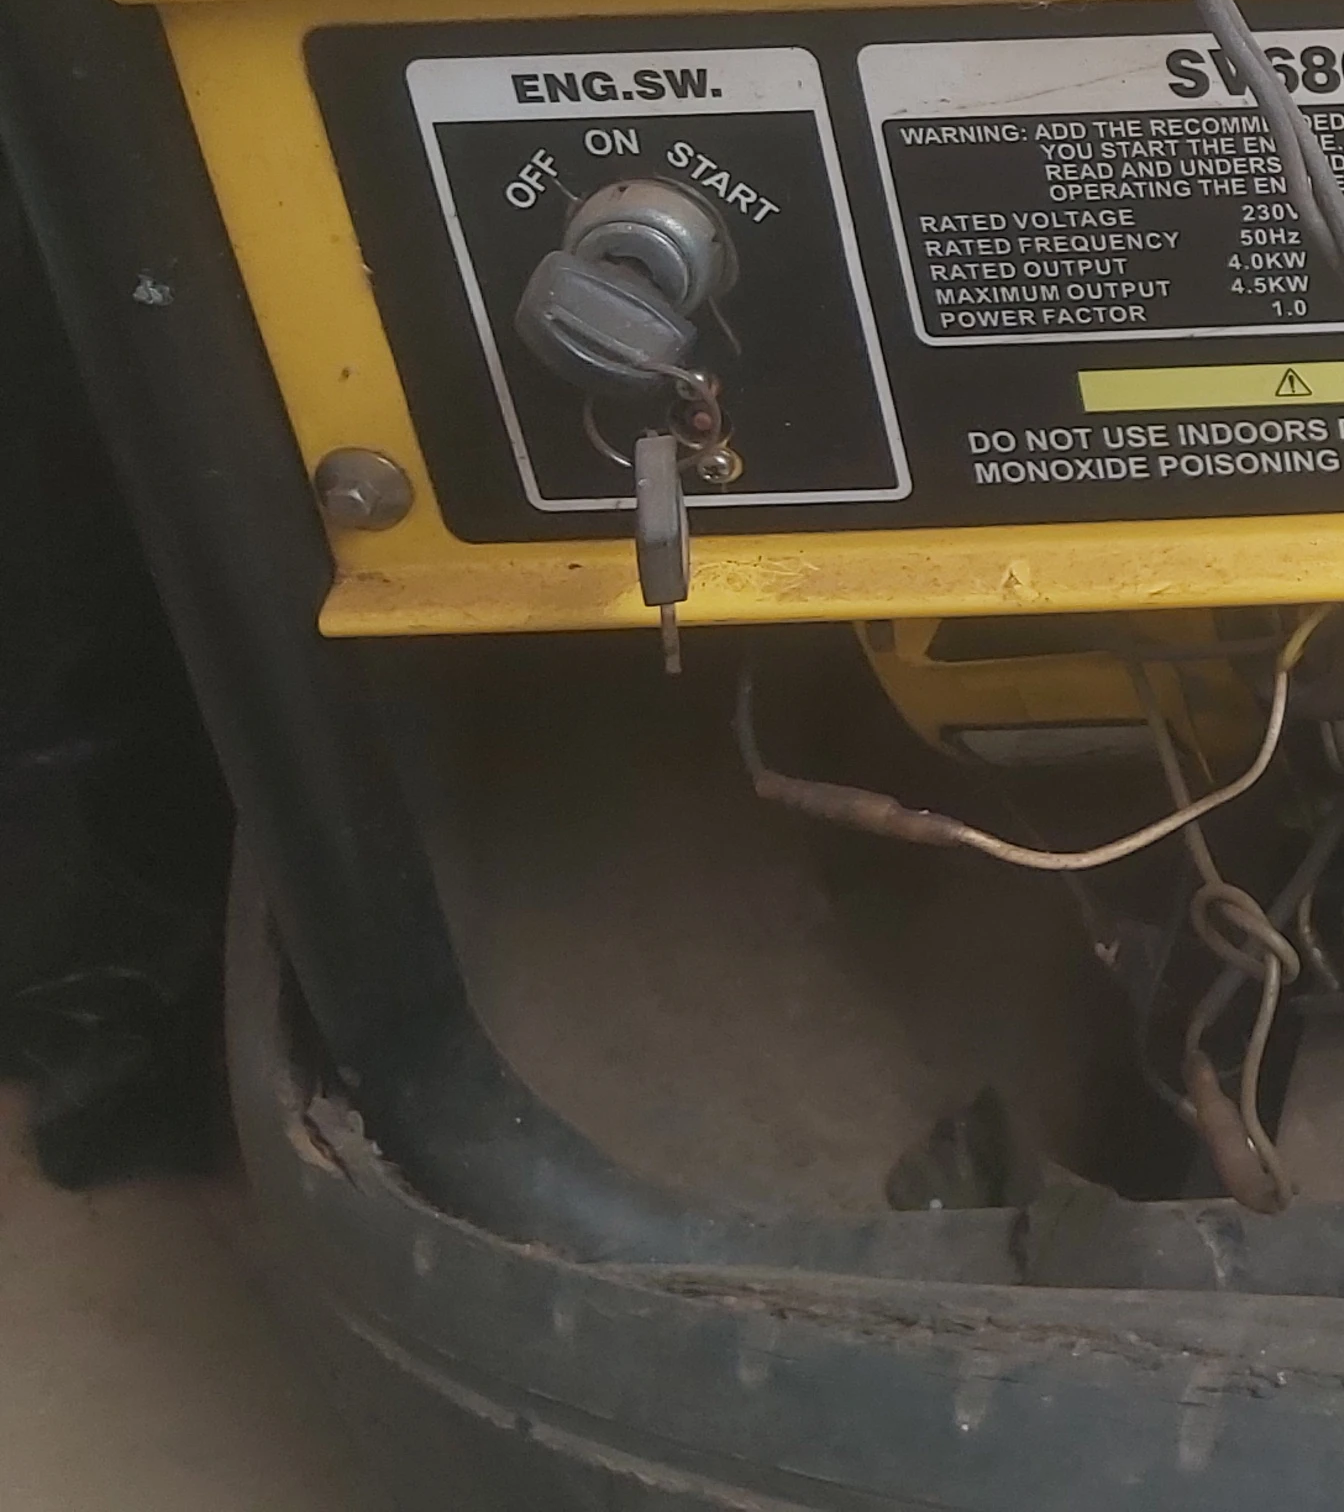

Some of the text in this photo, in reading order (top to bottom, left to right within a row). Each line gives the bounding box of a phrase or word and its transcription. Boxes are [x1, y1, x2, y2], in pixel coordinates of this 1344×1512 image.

[510, 68, 723, 104] ENG.SW.
[583, 128, 641, 156] ON
[900, 123, 1028, 145] WARNING:
[1034, 122, 1087, 141] ADD
[1093, 120, 1150, 139] THE
[1040, 143, 1093, 161] YOU
[1100, 140, 1178, 159] START
[1186, 138, 1236, 156] THE
[504, 148, 561, 211] OFF
[666, 141, 781, 225] START
[1045, 161, 1114, 181] READ
[1120, 159, 1173, 178] AND
[1049, 178, 1192, 202] OPERATING
[1198, 178, 1248, 196] THE
[920, 213, 1007, 233] RATED
[1013, 209, 1135, 229] VOLTAGE
[925, 228, 1301, 258] RATED FREQUENCY 50Hz
[930, 251, 1307, 282] RATED OUTPUT 4.0KW
[936, 274, 1309, 306] MAXIMUM OUTPUT 4.5KW
[940, 299, 1308, 329] POWER FACTOR 1.0
[967, 431, 1016, 454] DO
[1026, 427, 1093, 451] NOT
[1102, 424, 1170, 449] USE
[1178, 419, 1329, 447] INDOORS
[974, 448, 1341, 484] MONOXIDE POISONING
